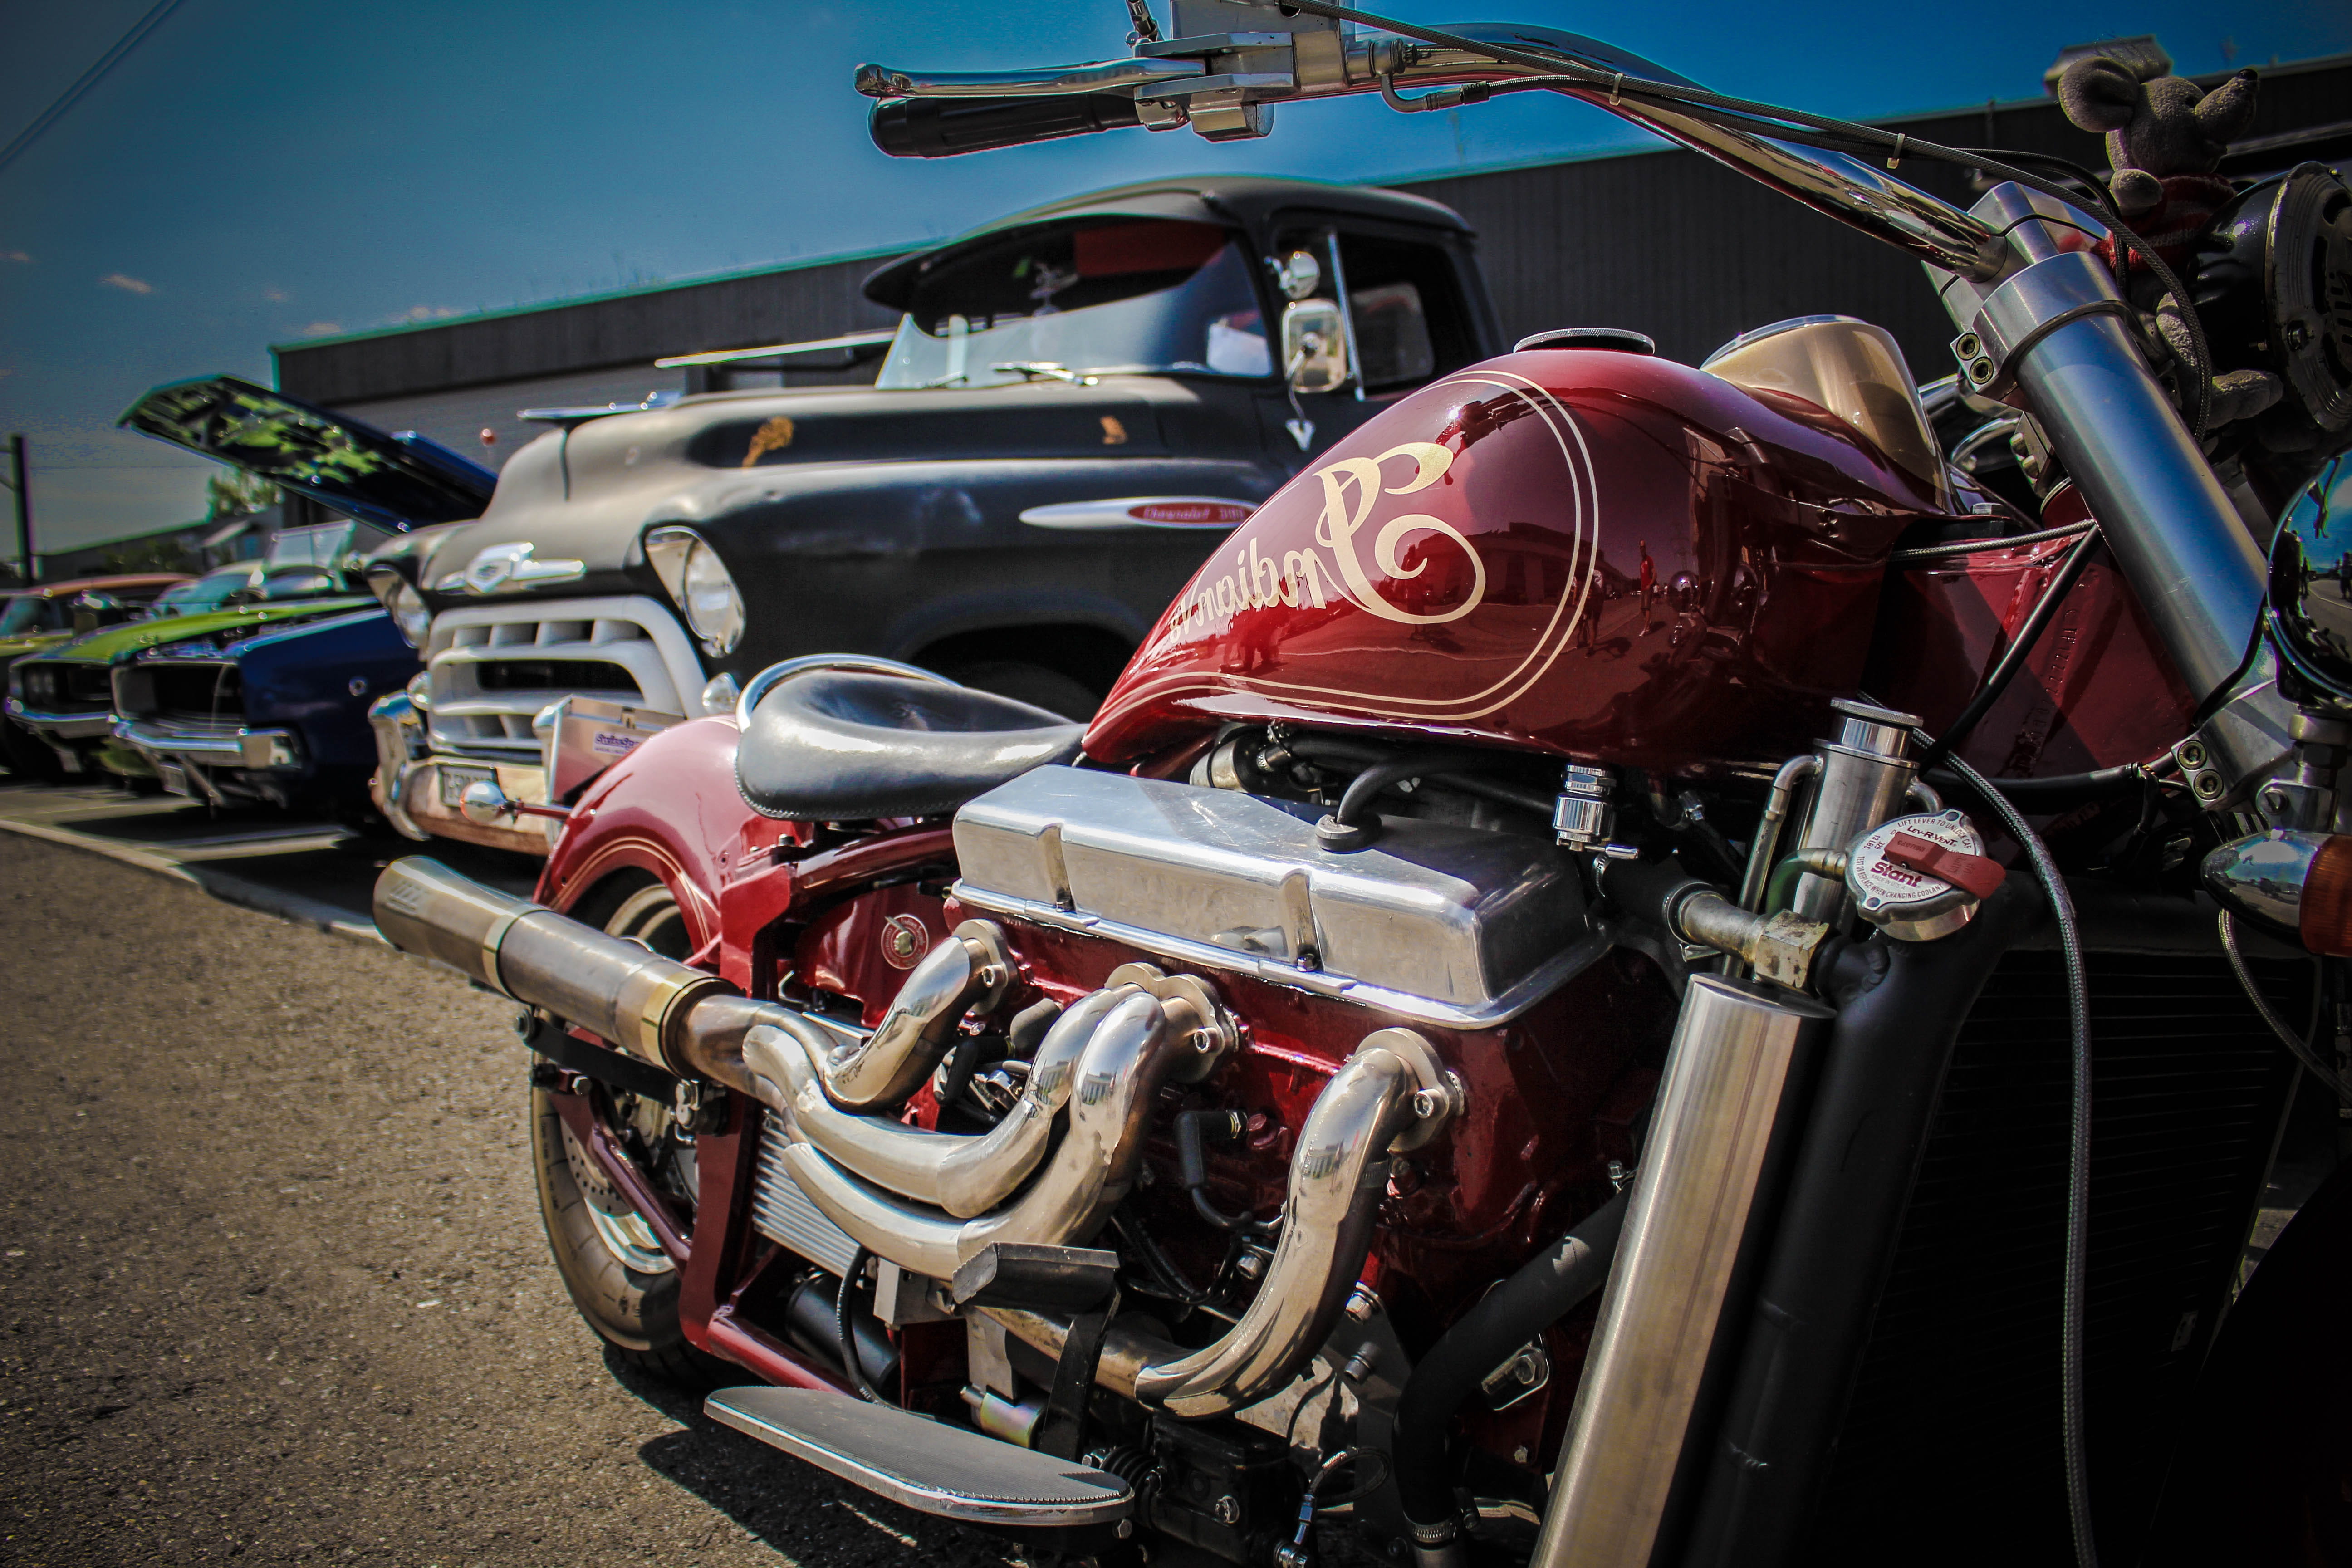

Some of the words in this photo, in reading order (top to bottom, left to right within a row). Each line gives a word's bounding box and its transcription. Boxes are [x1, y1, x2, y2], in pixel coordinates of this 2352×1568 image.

[1945, 823, 1965, 839] UNLOCK
[1962, 838, 1972, 849] CAP
[1864, 839, 1876, 850] LBS
[1874, 841, 1885, 850] 329
[1897, 840, 1926, 852] CAUTION
[1856, 856, 1865, 866] TEST
[1870, 862, 1923, 887] Stant
[1858, 872, 1874, 889] REPLACE
[1871, 886, 1886, 897] WHEN
[1886, 891, 1916, 899] CHANGING
[1917, 883, 1944, 897] COOLANT
